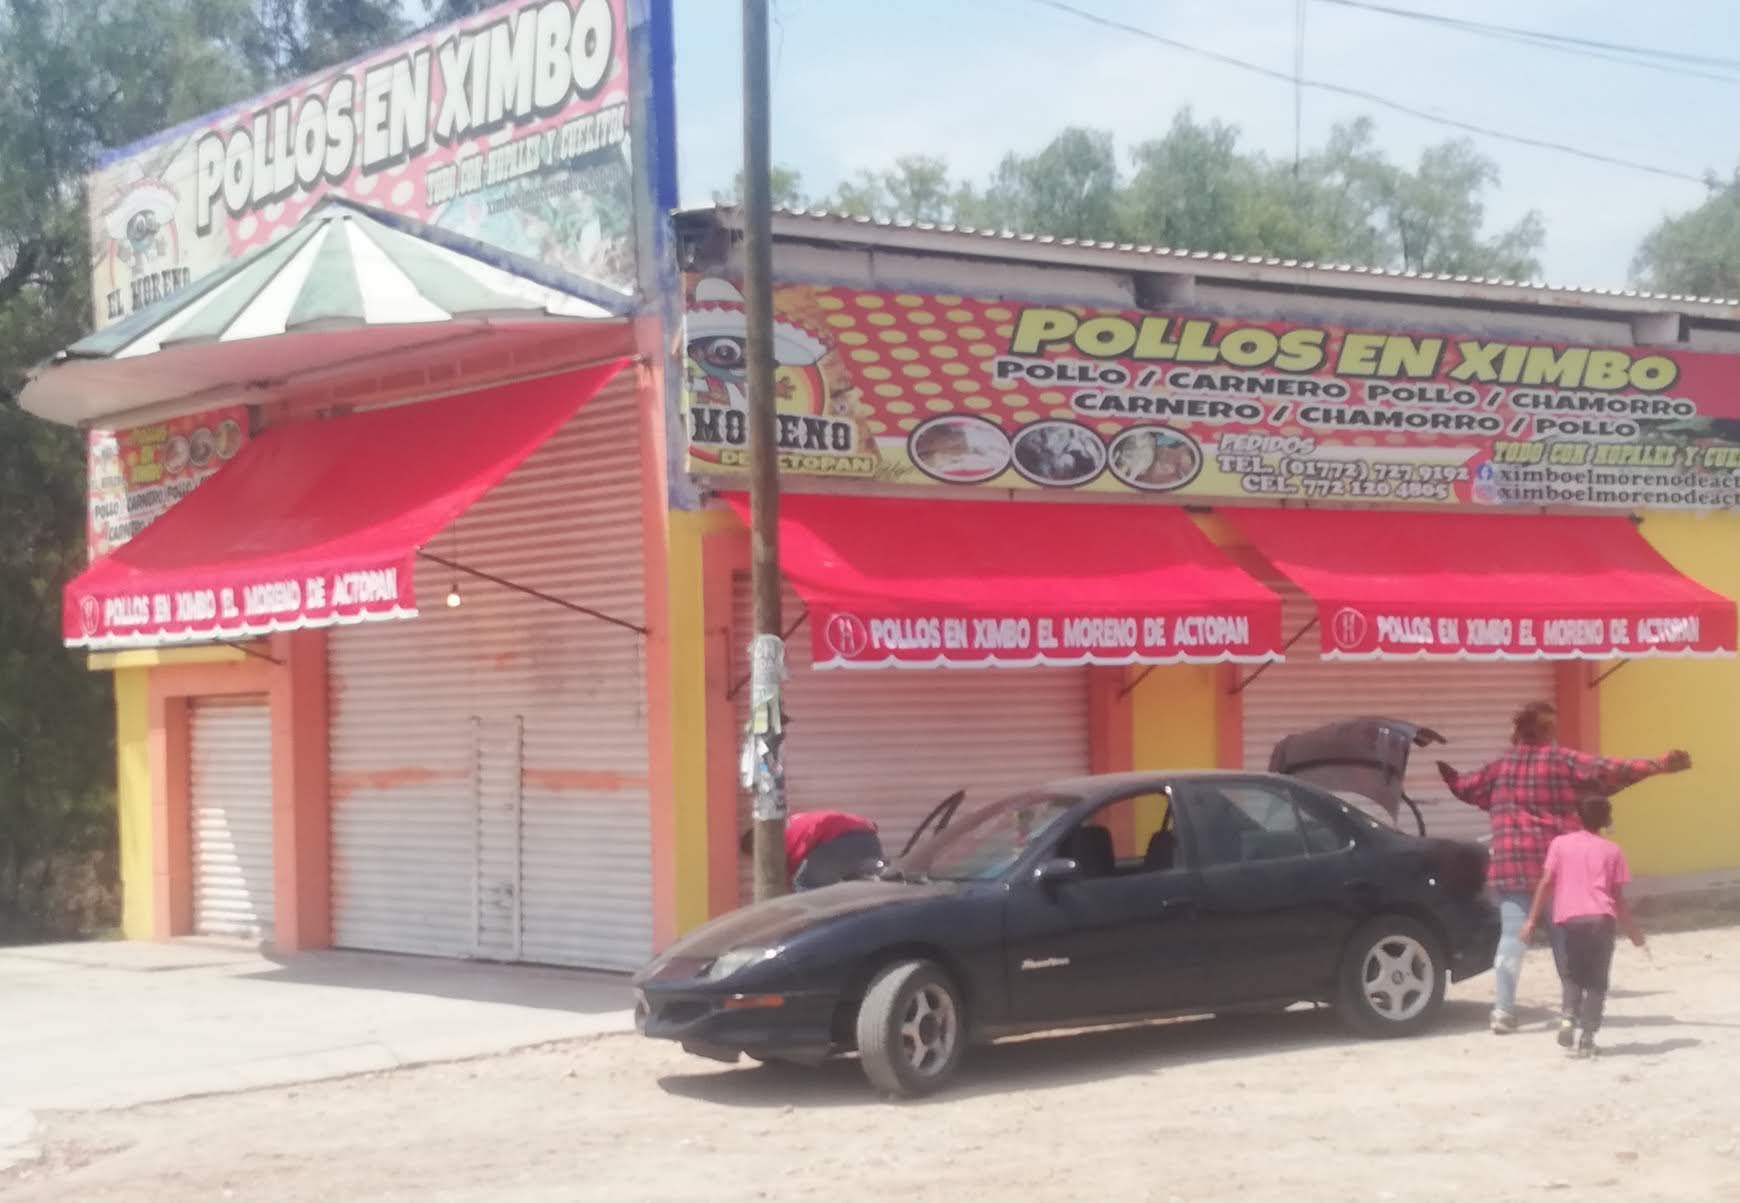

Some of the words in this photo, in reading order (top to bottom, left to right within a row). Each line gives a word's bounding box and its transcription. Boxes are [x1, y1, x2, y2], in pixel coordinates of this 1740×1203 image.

[196, 76, 355, 236] POLLOS
[362, 48, 431, 173] EN
[435, 0, 614, 140] XIMBO
[107, 289, 125, 320] EL
[1010, 307, 1328, 373] POLLOS
[1335, 333, 1445, 378] EN
[1448, 340, 1679, 391] XIMBO
[997, 360, 1128, 386] POLLO
[1168, 372, 1348, 399] CARNERO
[1367, 384, 1477, 406] POLLO
[1512, 391, 1696, 417] CHAMORRO
[691, 407, 852, 451] MOENO
[1073, 393, 1262, 421] CARNERO
[1299, 405, 1502, 432] CHAMORRO
[1536, 418, 1638, 439] POLLO
[1219, 434, 1316, 454] PEDIDOS
[1494, 441, 1544, 463] TODO
[1550, 443, 1589, 464] CON
[1684, 446, 1699, 466] Y
[1218, 455, 1274, 474] TEL.
[1280, 458, 1369, 481] (01772)
[1375, 463, 1413, 480] 727
[1420, 464, 1470, 482] 9192
[1242, 475, 1297, 494] CEL.
[1303, 479, 1345, 496] 772
[1350, 480, 1391, 496] 120
[104, 594, 150, 626] POLLOS
[153, 591, 171, 622] EN
[175, 588, 216, 621] XIMBO
[220, 587, 239, 618] EL
[244, 580, 301, 617] MORENO
[306, 576, 326, 609] DE
[331, 568, 398, 607] ACTOPAN
[870, 617, 941, 650] POLLOS
[944, 619, 968, 649] EN
[972, 618, 1030, 648] XIMBO
[1037, 618, 1059, 648] EL
[1063, 617, 1137, 648] MORENO
[1143, 617, 1166, 647] DE
[1173, 616, 1249, 645] ACTOPAN
[1377, 615, 1434, 644] POLLOS
[1437, 617, 1459, 644] EN
[1465, 617, 1512, 645] XIMBO
[1519, 618, 1537, 646] EL
[1543, 617, 1605, 645] MORENO
[1610, 618, 1628, 645] DE
